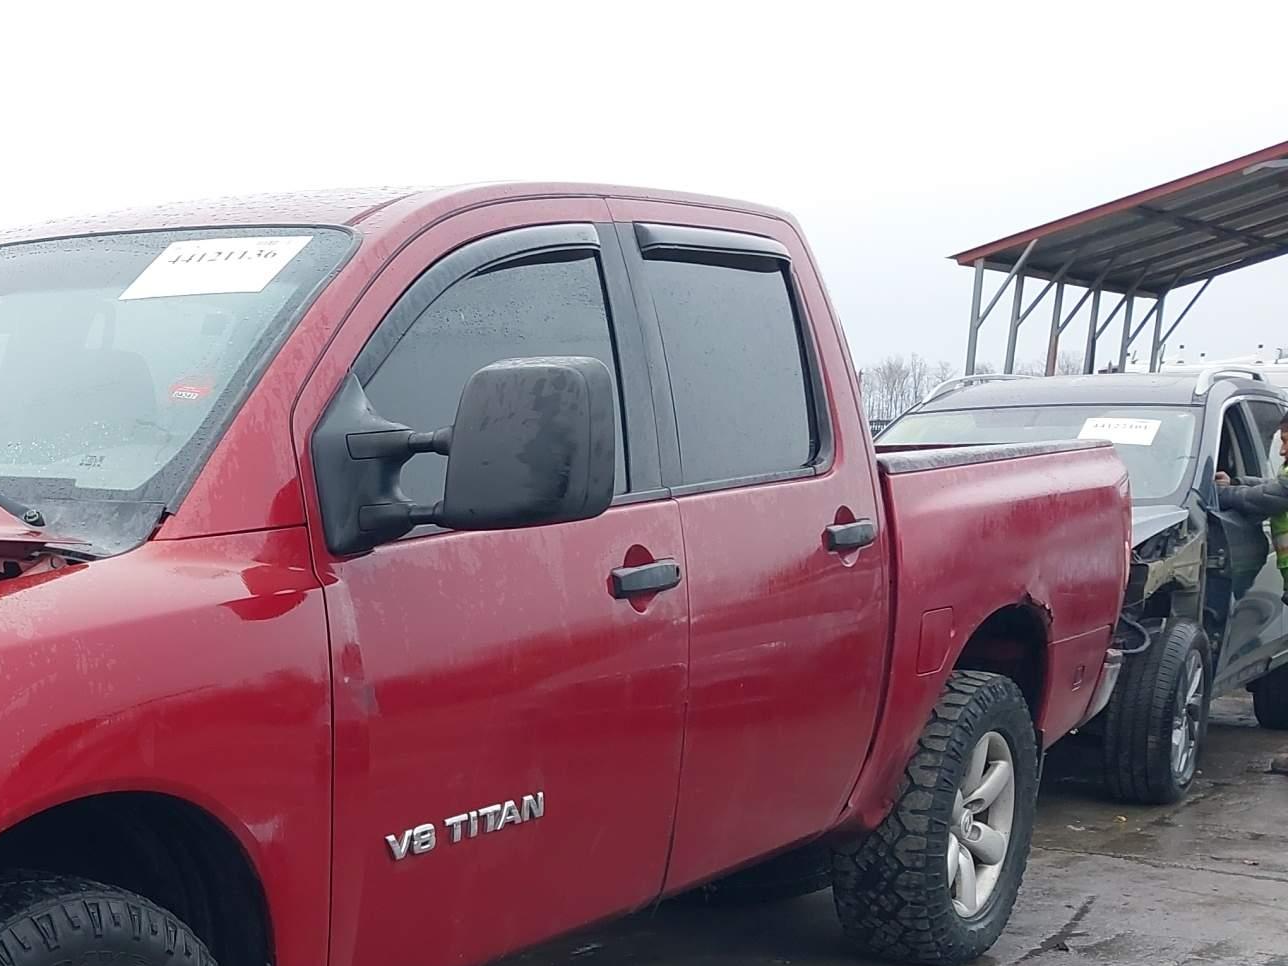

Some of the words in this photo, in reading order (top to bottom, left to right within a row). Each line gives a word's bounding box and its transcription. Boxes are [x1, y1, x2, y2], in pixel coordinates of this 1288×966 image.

[167, 249, 279, 265] 44121136
[384, 822, 436, 861] V8
[443, 791, 545, 844] TITAN
